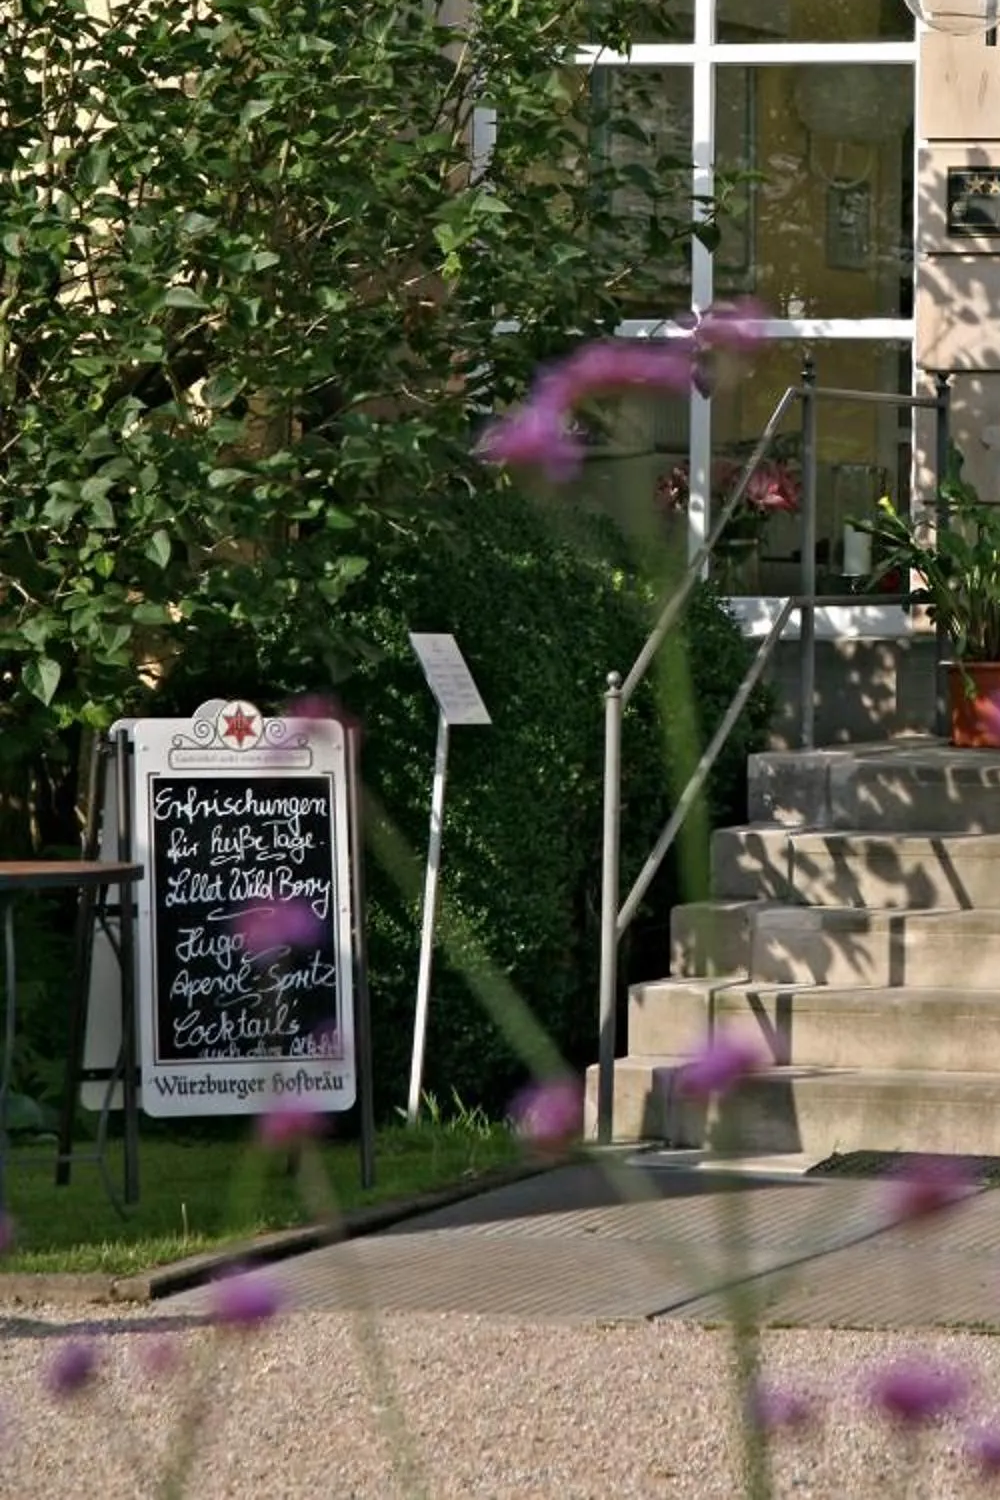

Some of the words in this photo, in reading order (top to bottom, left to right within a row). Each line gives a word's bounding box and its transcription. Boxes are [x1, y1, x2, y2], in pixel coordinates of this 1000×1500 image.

[154, 786, 328, 837] Erfrischungen
[167, 827, 200, 864] für
[211, 824, 270, 862] heiße
[165, 868, 226, 907] Lillet
[229, 867, 275, 900] Wild
[176, 927, 245, 970] Hugo
[153, 1073, 265, 1099] Würzburger
[272, 1069, 345, 1095] Hofbräu
